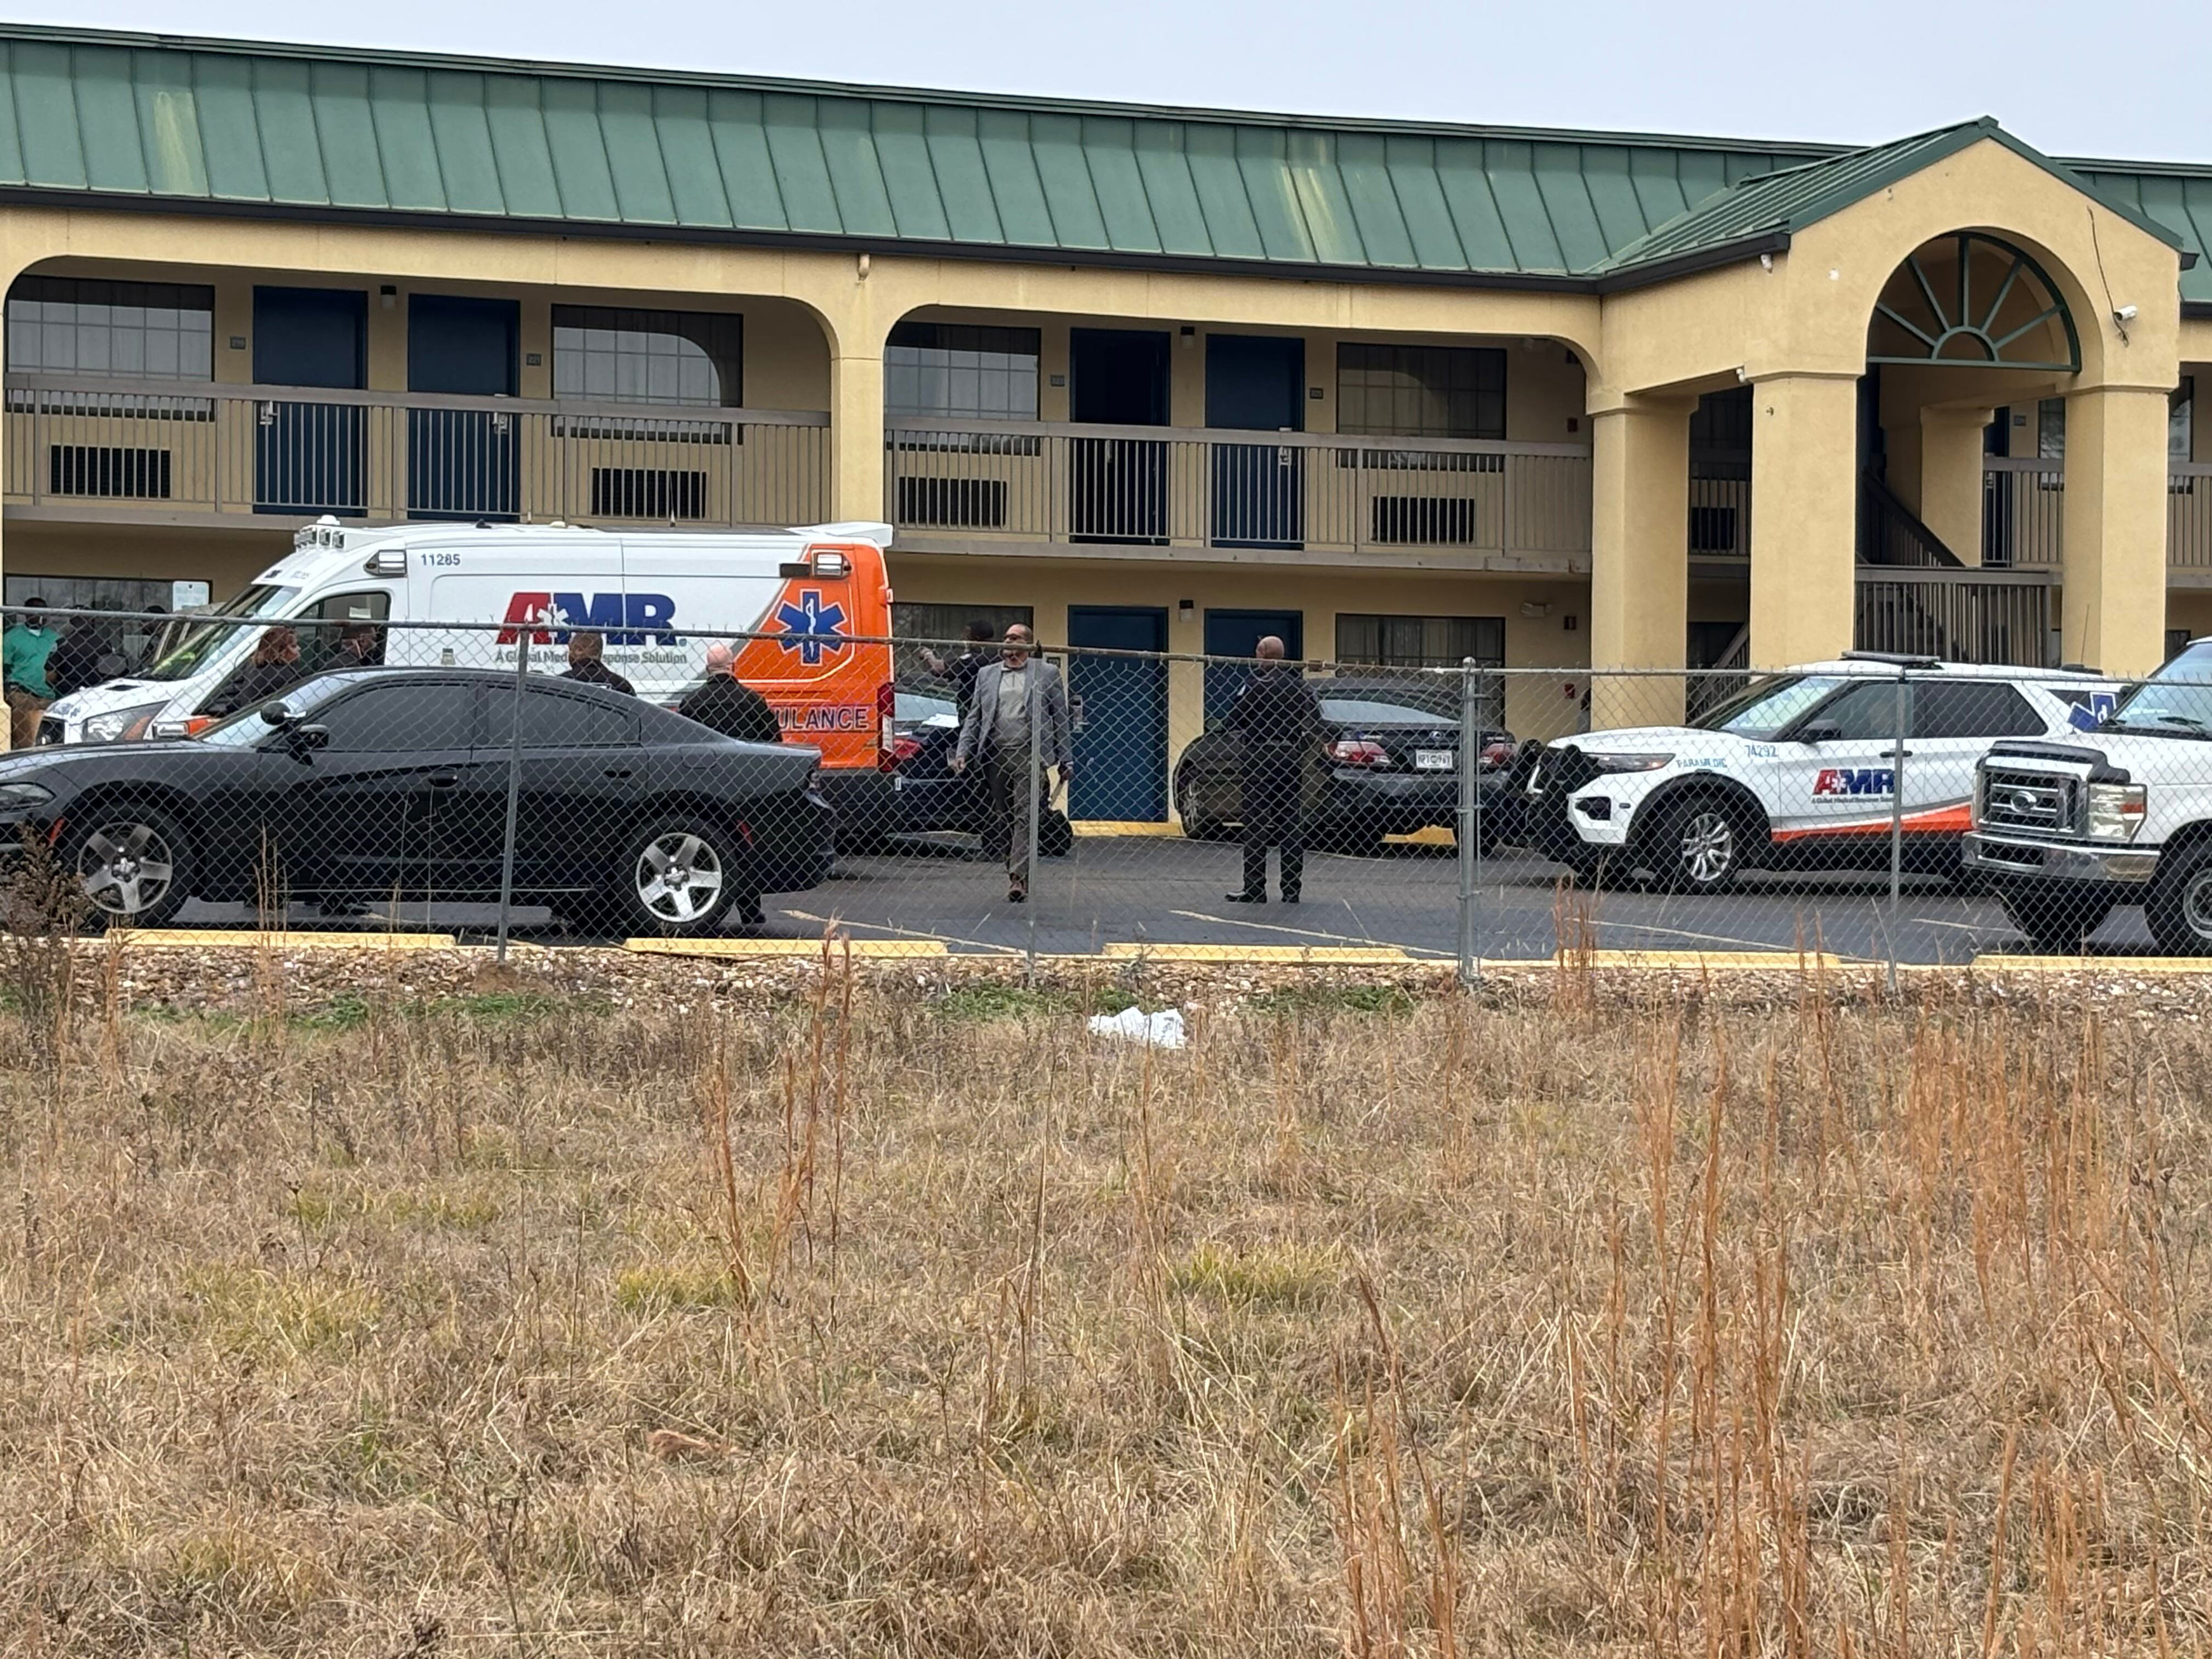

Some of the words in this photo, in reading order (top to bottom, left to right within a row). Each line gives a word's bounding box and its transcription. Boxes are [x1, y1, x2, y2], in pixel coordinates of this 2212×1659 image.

[421, 553, 461, 566] 11285
[495, 592, 676, 645] AMR
[506, 650, 542, 662] Glal
[603, 654, 640, 665] sponse
[776, 707, 869, 730] ULANCE
[1813, 769, 1895, 794] AMR
